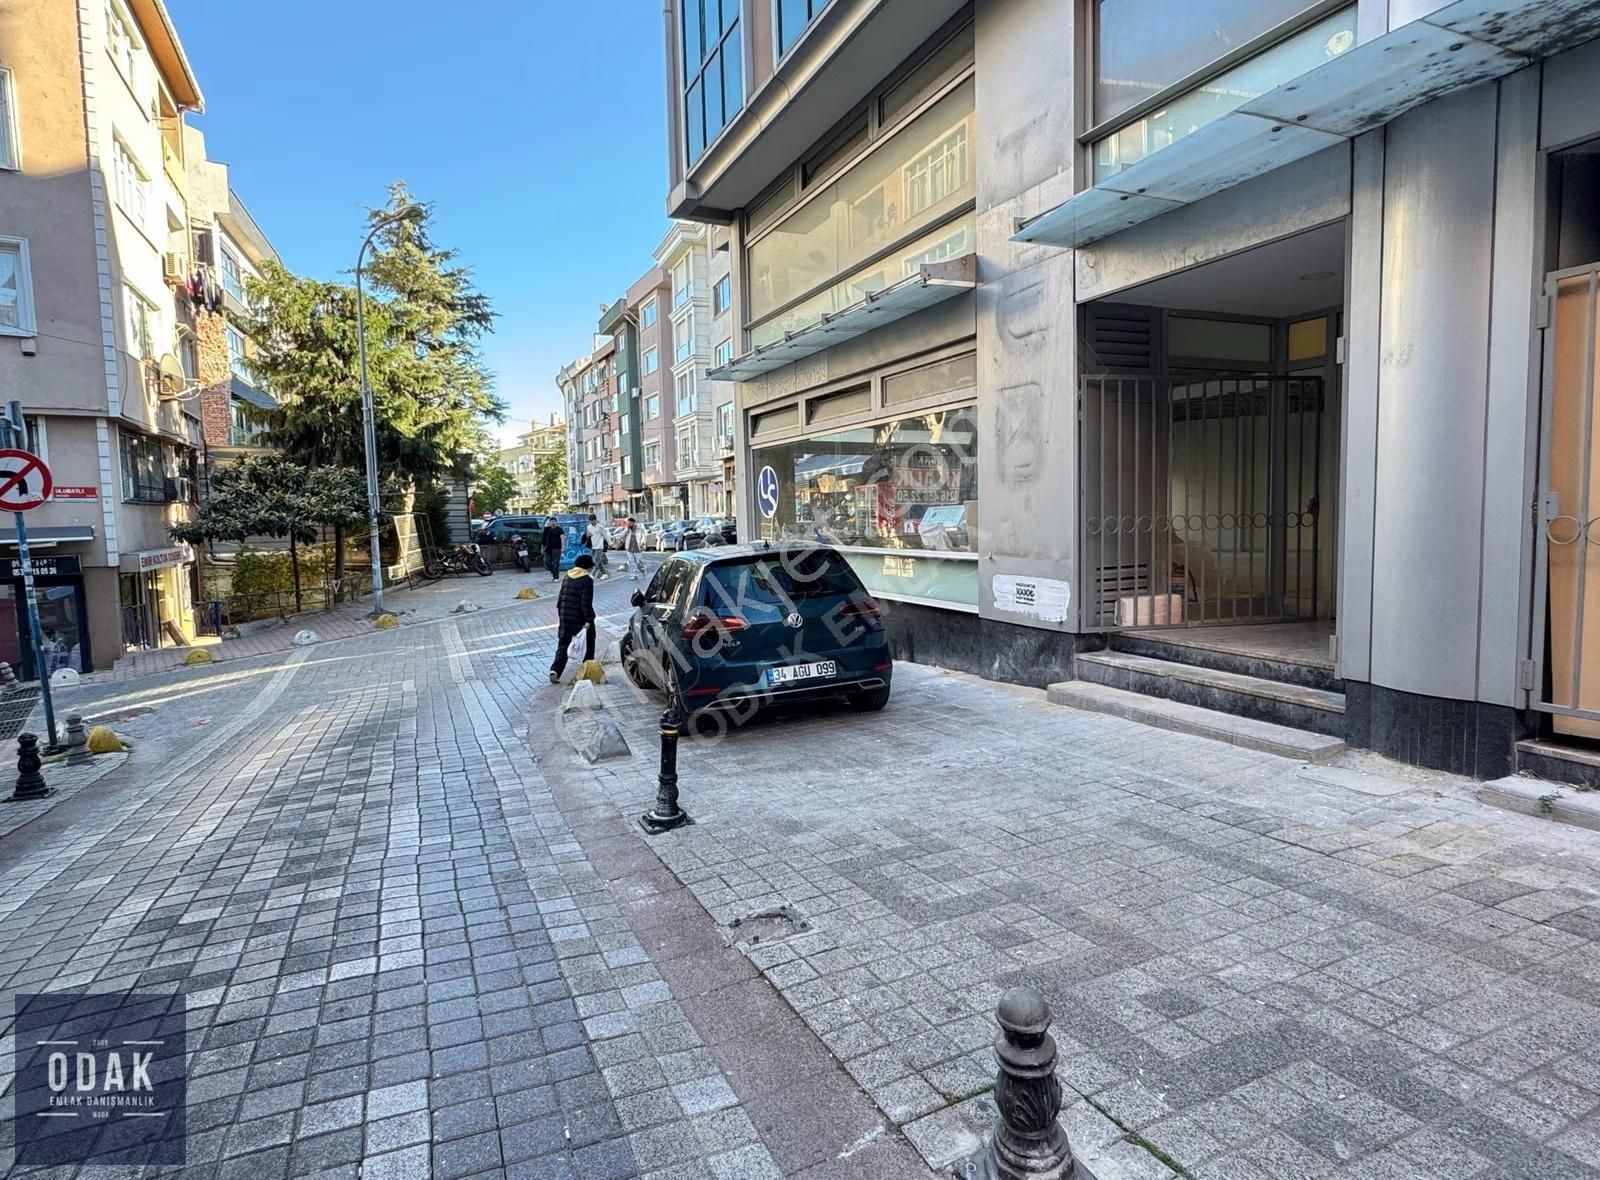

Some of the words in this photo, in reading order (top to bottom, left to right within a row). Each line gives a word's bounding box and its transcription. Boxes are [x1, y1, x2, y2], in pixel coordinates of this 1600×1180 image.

[774, 669, 787, 681] 34
[792, 666, 812, 679] AGU
[816, 661, 835, 675] 099
